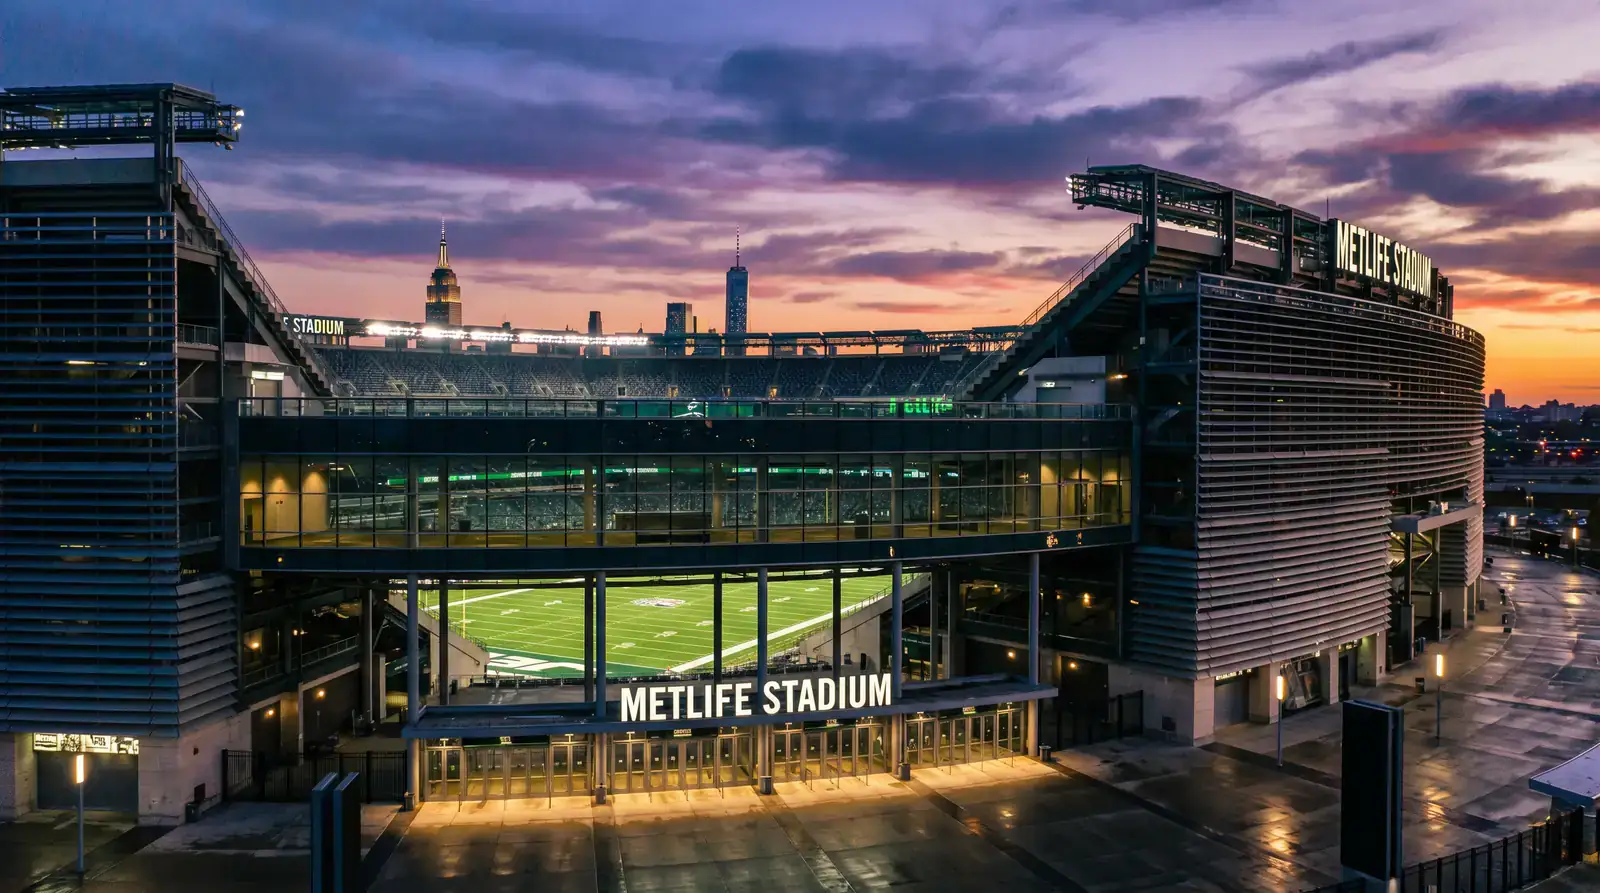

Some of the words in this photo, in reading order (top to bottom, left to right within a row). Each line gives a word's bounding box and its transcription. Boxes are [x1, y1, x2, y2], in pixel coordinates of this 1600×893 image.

[1337, 220, 1391, 283] METLIFE
[1393, 242, 1431, 298] STADIUM
[293, 317, 344, 335] STADIUM
[621, 682, 752, 722] METLIFE
[762, 673, 891, 715] STADIUM
